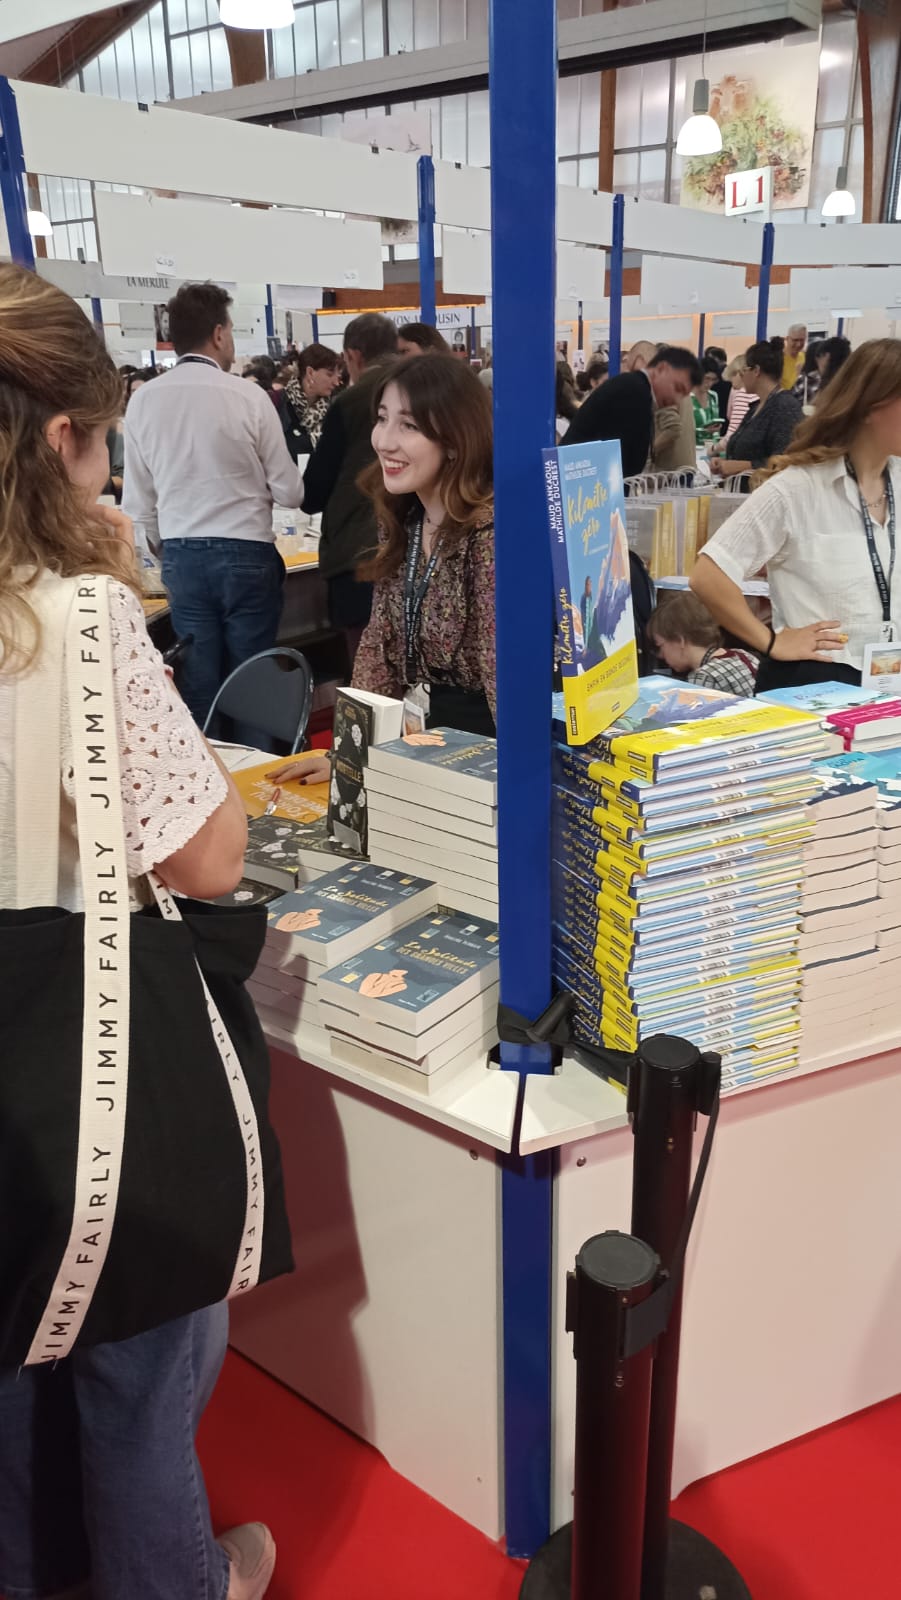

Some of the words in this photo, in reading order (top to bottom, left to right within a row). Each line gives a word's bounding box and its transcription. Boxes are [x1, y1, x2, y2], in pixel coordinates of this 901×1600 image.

[554, 502, 565, 543] MATHILDE
[83, 685, 110, 809] JIMMY
[95, 841, 118, 972] FAIRLY
[95, 992, 119, 1112] JIMMY
[242, 1112, 260, 1212] JIMMY
[41, 1281, 85, 1361] JIMMY
[76, 1146, 112, 1265] FAIRLY
